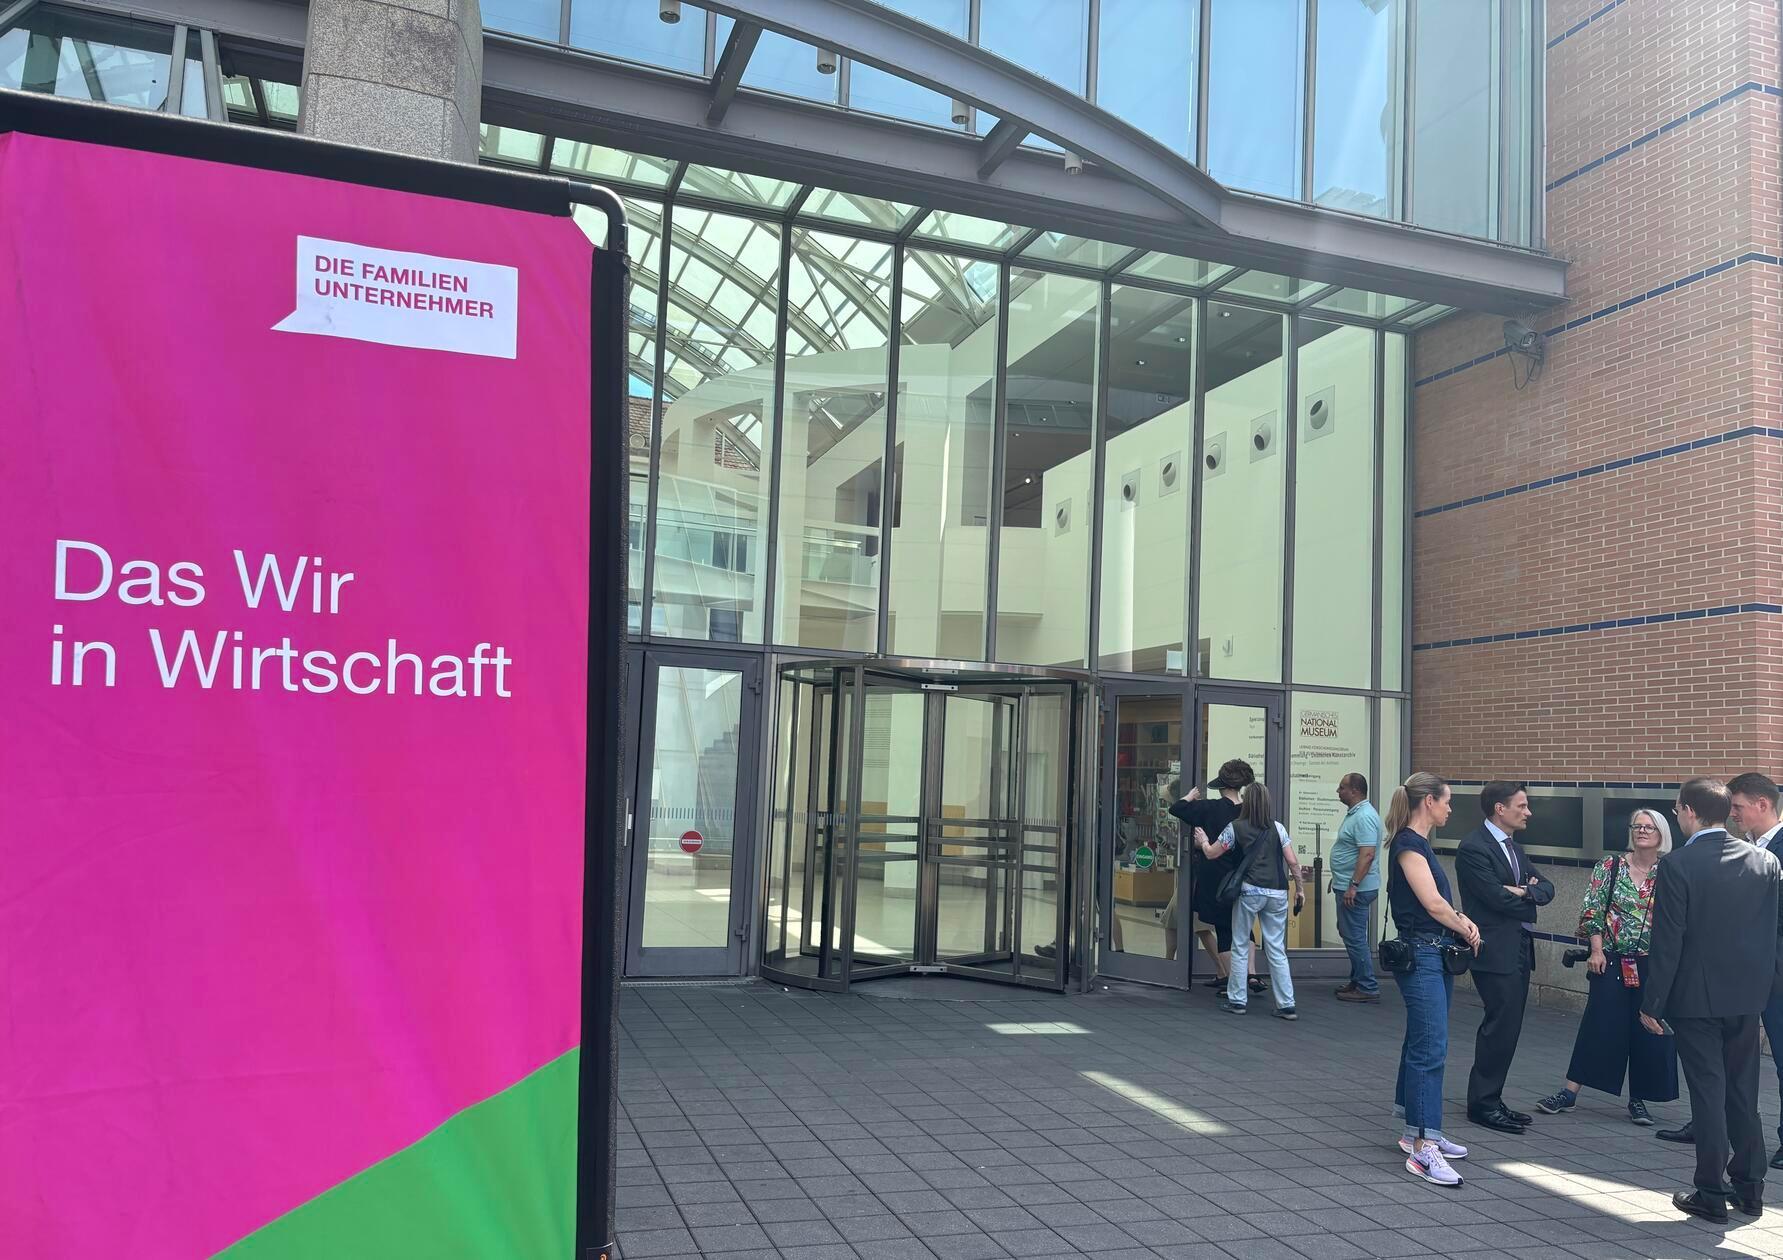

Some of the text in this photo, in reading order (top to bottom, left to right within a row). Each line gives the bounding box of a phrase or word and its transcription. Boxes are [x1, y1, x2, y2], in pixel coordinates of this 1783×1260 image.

[315, 255, 468, 293] DIE FAMILIEN
[315, 278, 494, 319] UNTERNEHMER
[55, 539, 354, 614] Das Wir
[51, 624, 512, 698] in Wirtschaft
[1300, 718, 1337, 728] NATIONAL
[1300, 727, 1337, 737] MUSEUM
